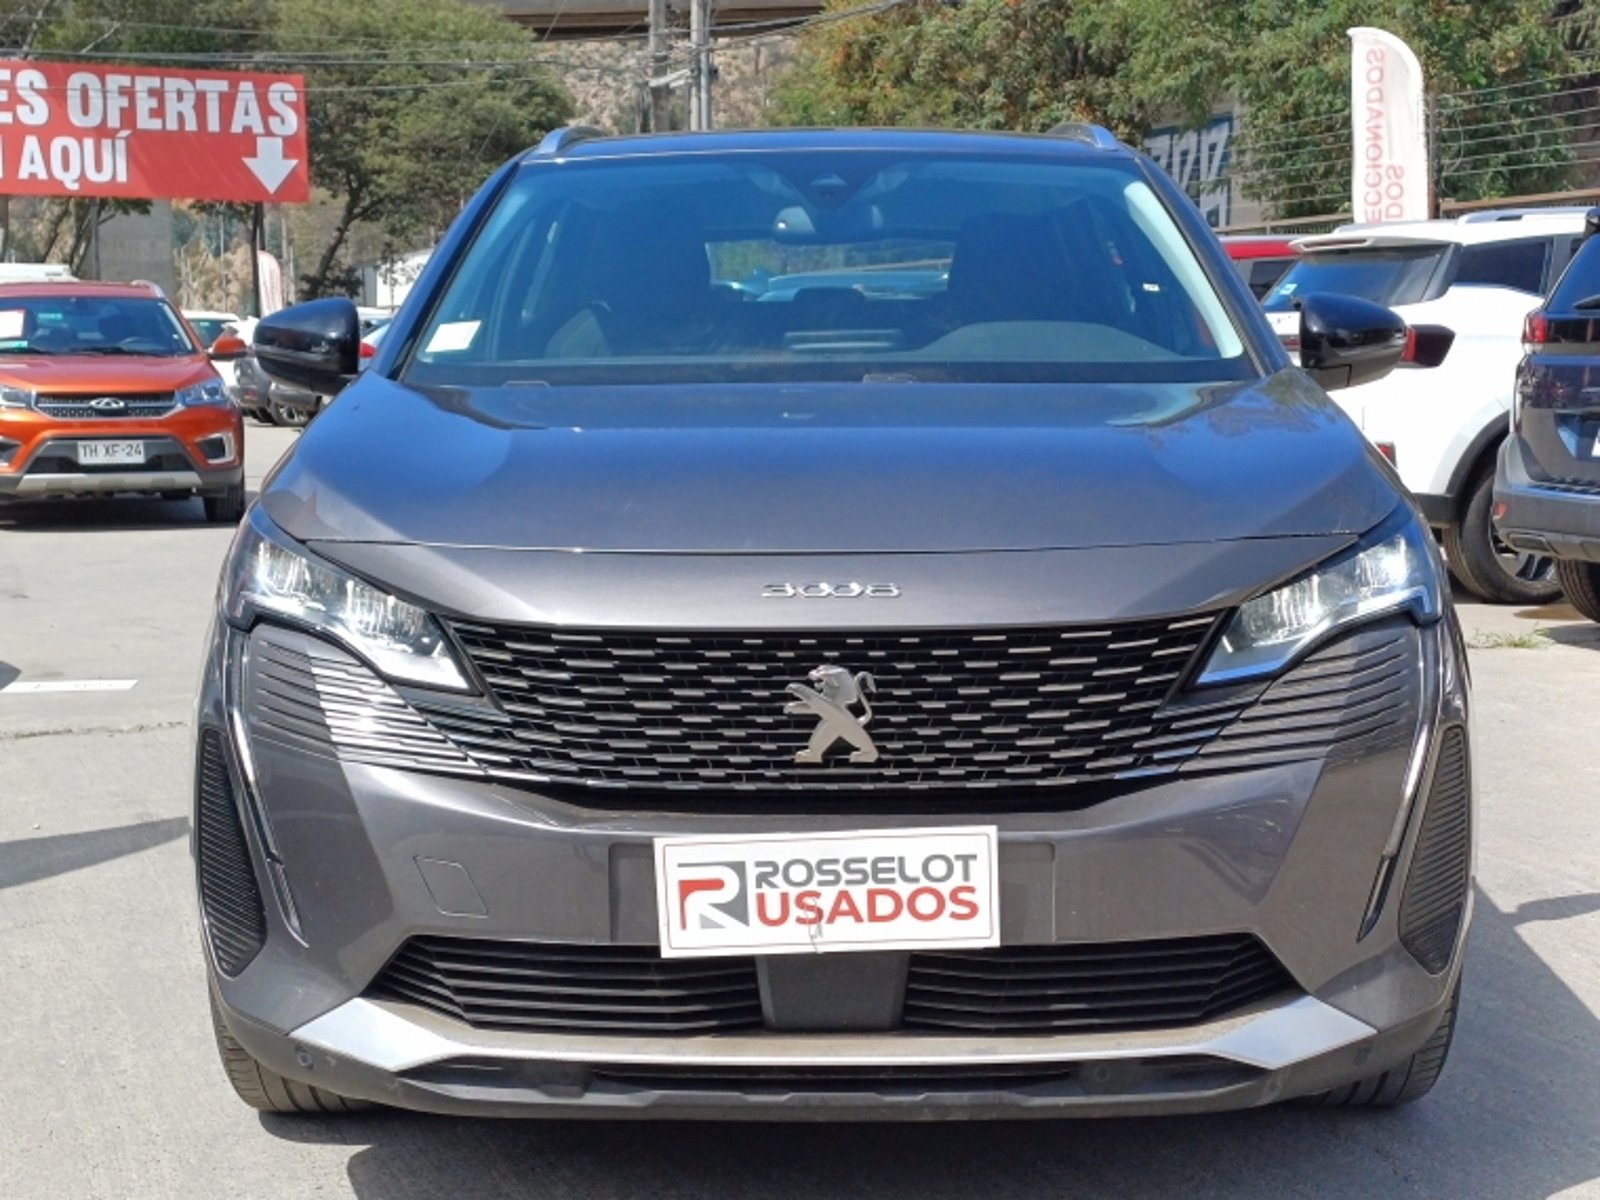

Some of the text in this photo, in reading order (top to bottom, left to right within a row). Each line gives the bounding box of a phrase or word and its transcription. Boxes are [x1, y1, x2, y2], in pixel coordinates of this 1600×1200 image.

[66, 72, 298, 136] OFERTAS
[18, 130, 132, 190] AQUÍ
[82, 443, 98, 457] TH
[761, 583, 902, 599] 3008
[754, 854, 978, 889] ROSSELOT
[756, 886, 980, 927] USADOS
